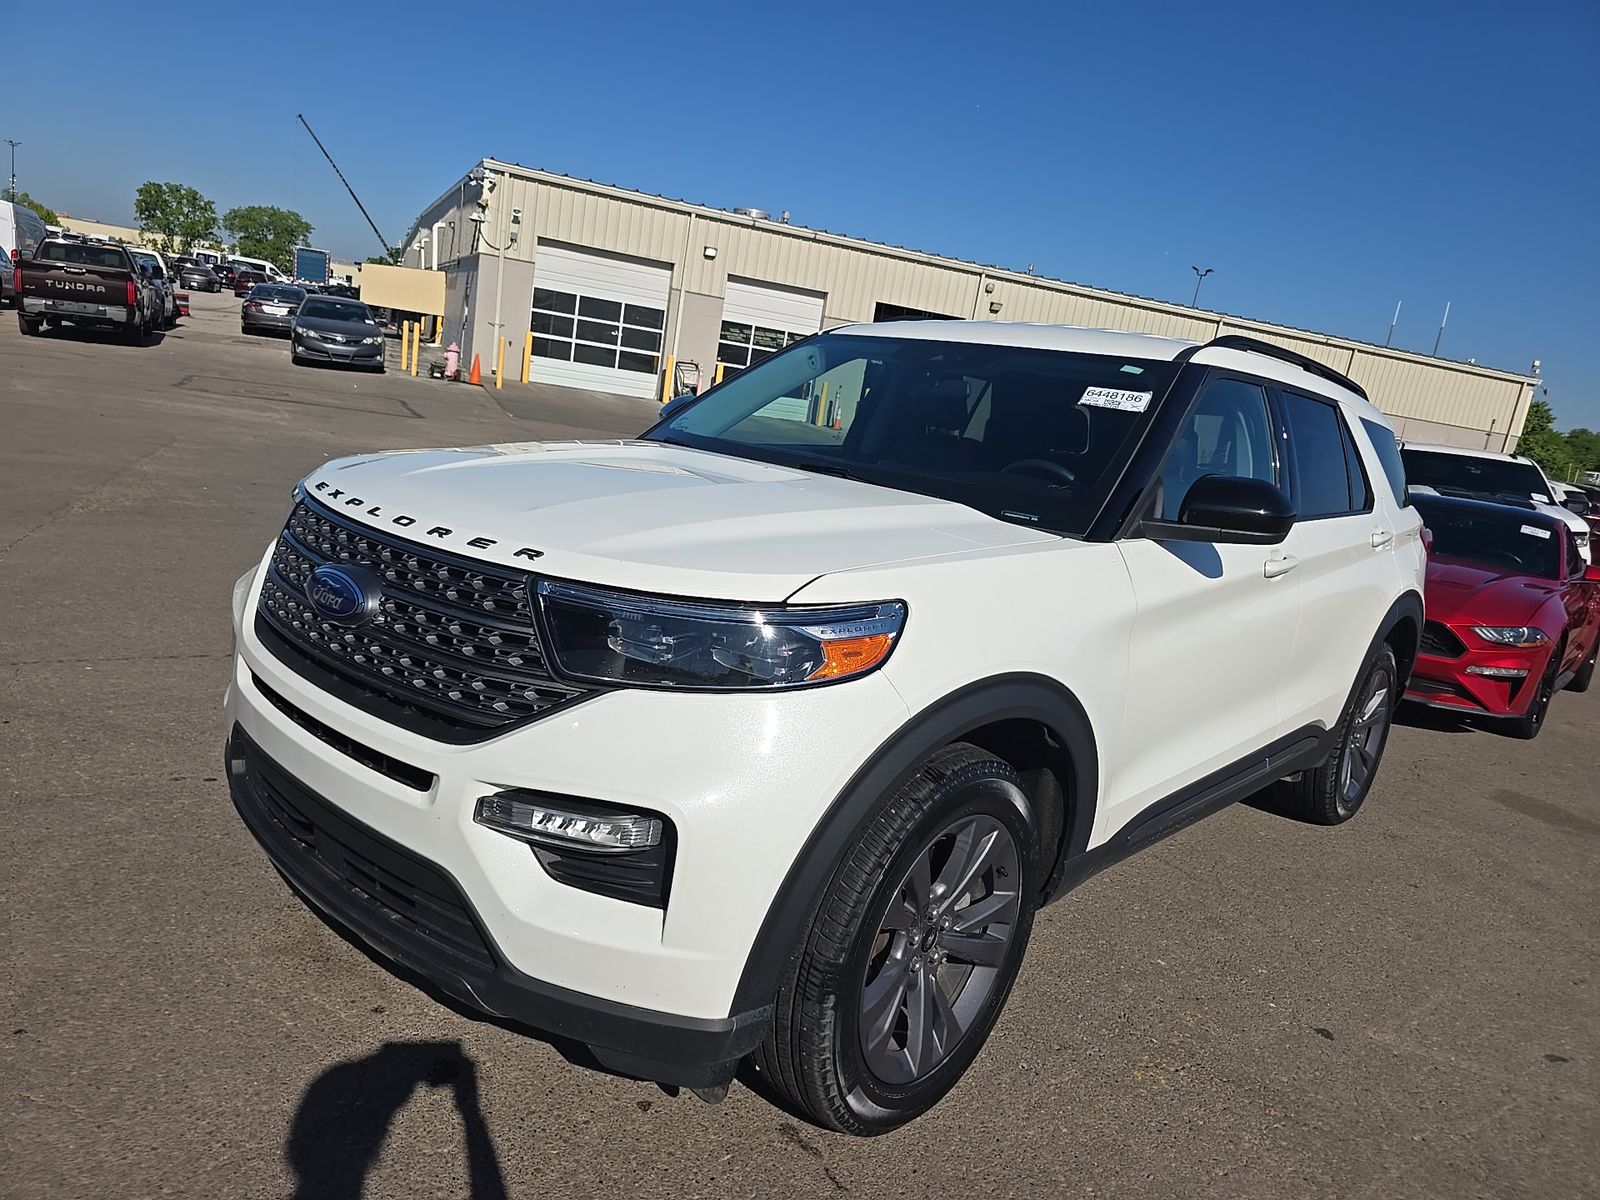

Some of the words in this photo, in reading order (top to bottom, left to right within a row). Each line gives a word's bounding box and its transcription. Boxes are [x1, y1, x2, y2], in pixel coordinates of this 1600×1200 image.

[45, 280, 106, 293] TUNDRA
[1086, 389, 1143, 403] 6448186
[314, 481, 545, 562] EXPLORER
[313, 577, 344, 610] Ford
